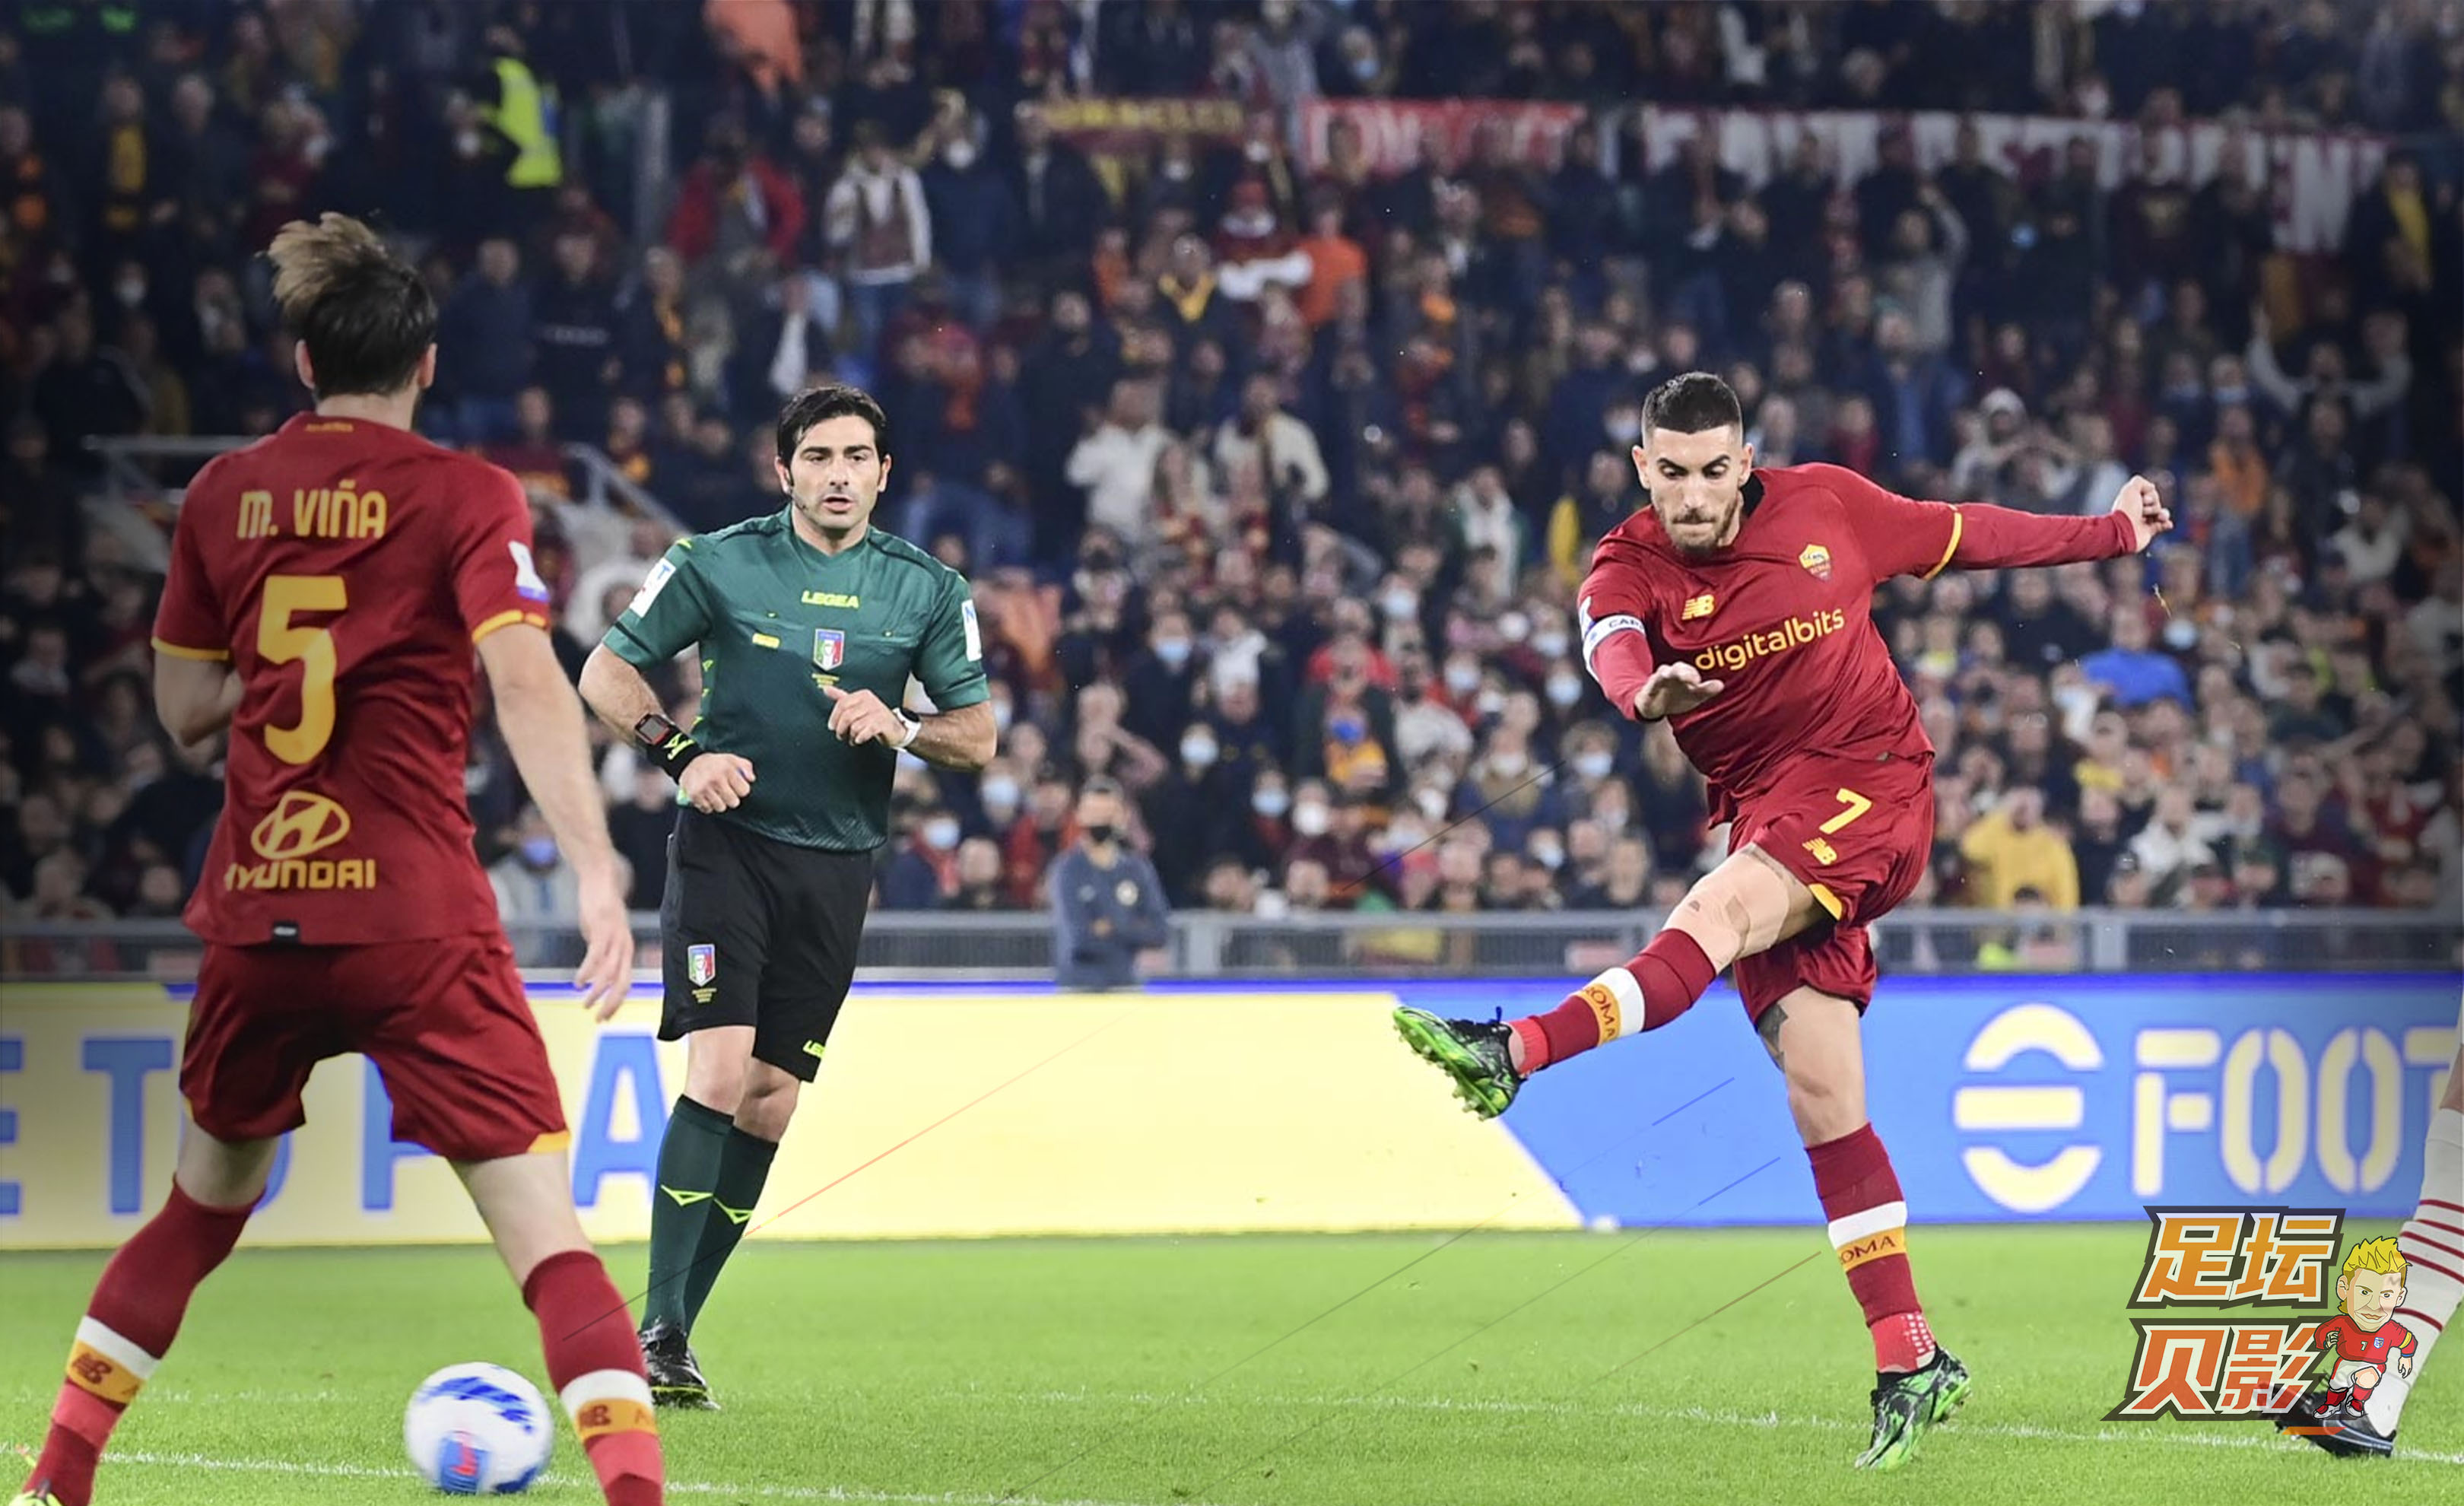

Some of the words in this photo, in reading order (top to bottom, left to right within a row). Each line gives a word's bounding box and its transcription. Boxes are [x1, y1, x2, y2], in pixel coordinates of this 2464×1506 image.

[237, 489, 279, 539] M.
[294, 479, 387, 539] VIÑA
[801, 589, 860, 608] LEGEA
[1694, 608, 1845, 671] digitalbits
[257, 574, 348, 765] 5
[1818, 787, 1873, 835] 7
[1838, 1234, 1897, 1266] OMA
